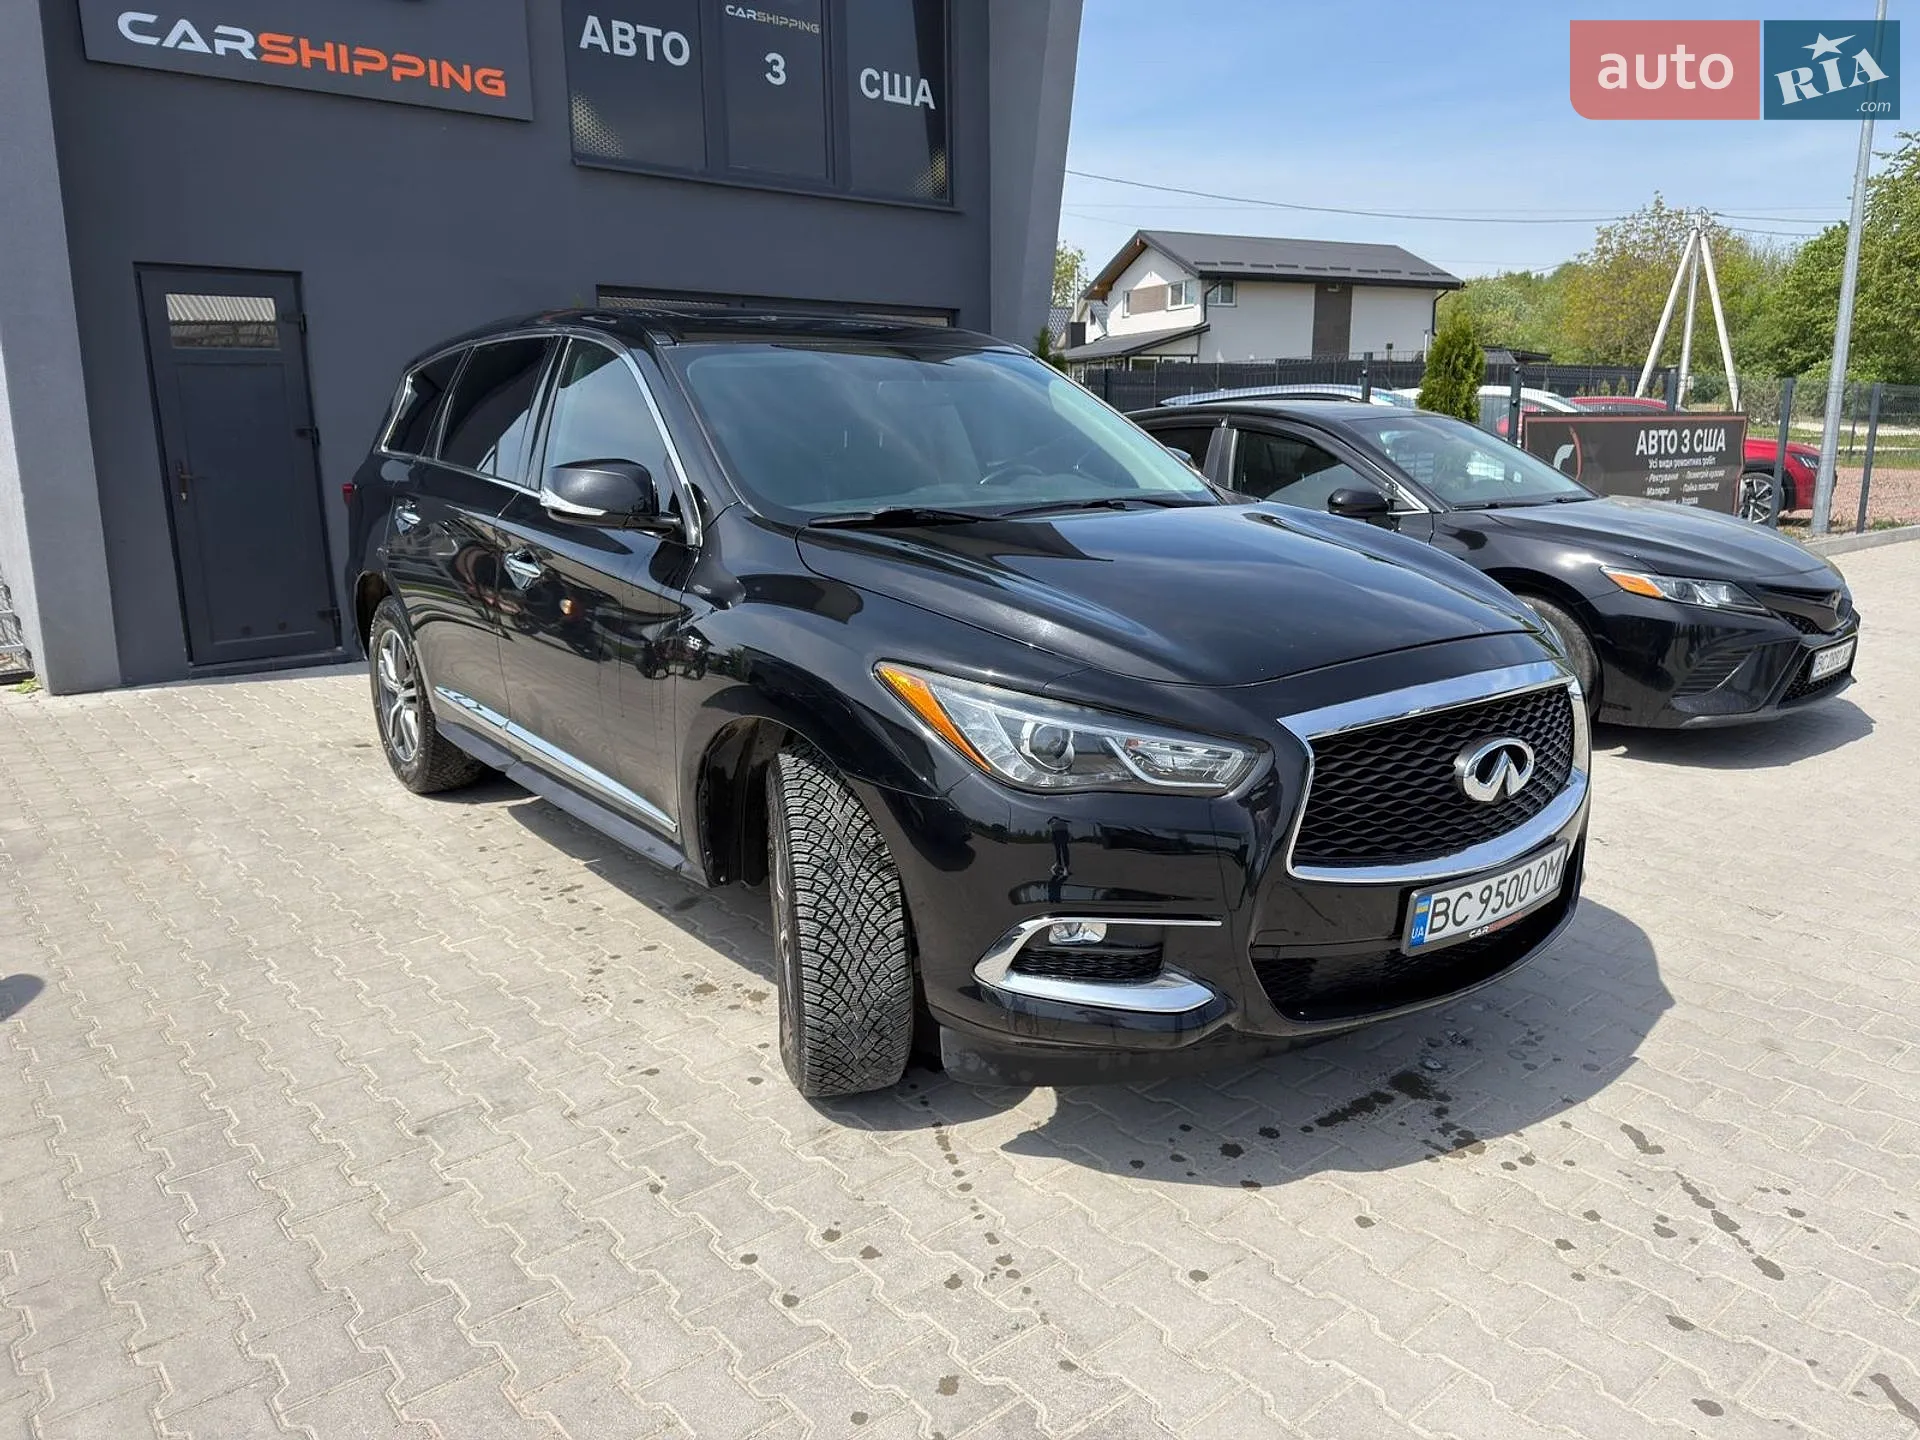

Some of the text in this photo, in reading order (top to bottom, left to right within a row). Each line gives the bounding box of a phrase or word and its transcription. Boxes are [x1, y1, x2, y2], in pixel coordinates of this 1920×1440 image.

[725, 4, 821, 35] CARSHIPPING
[117, 11, 507, 98] CARSHIPPING
[579, 14, 691, 67] АВТО
[859, 67, 936, 110] США
[1635, 428, 1678, 456] АВТО
[1693, 427, 1726, 453] США
[1428, 891, 1472, 934] BC
[1476, 868, 1532, 921] 9500
[1533, 851, 1564, 894] OM
[1411, 927, 1424, 940] UA
